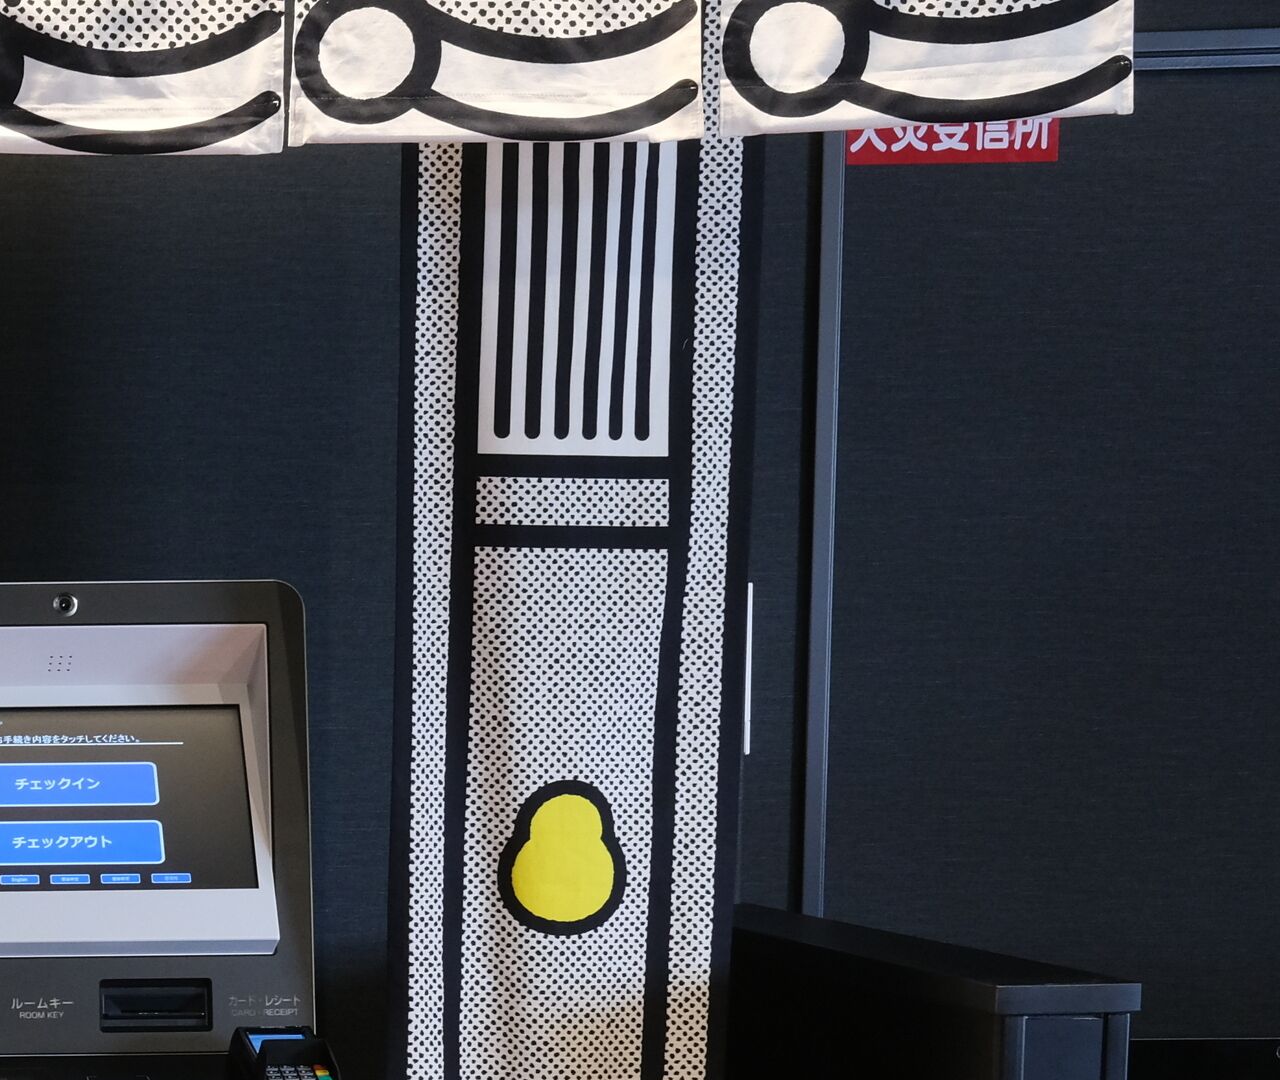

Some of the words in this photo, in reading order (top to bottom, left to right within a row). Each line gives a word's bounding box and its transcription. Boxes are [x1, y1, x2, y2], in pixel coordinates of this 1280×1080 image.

[14, 778, 101, 790] チェックイン
[11, 835, 113, 849] チェックアウト
[10, 997, 74, 1009] ルームキー
[19, 1011, 45, 1019] ROOM
[46, 1011, 65, 1019] KEY
